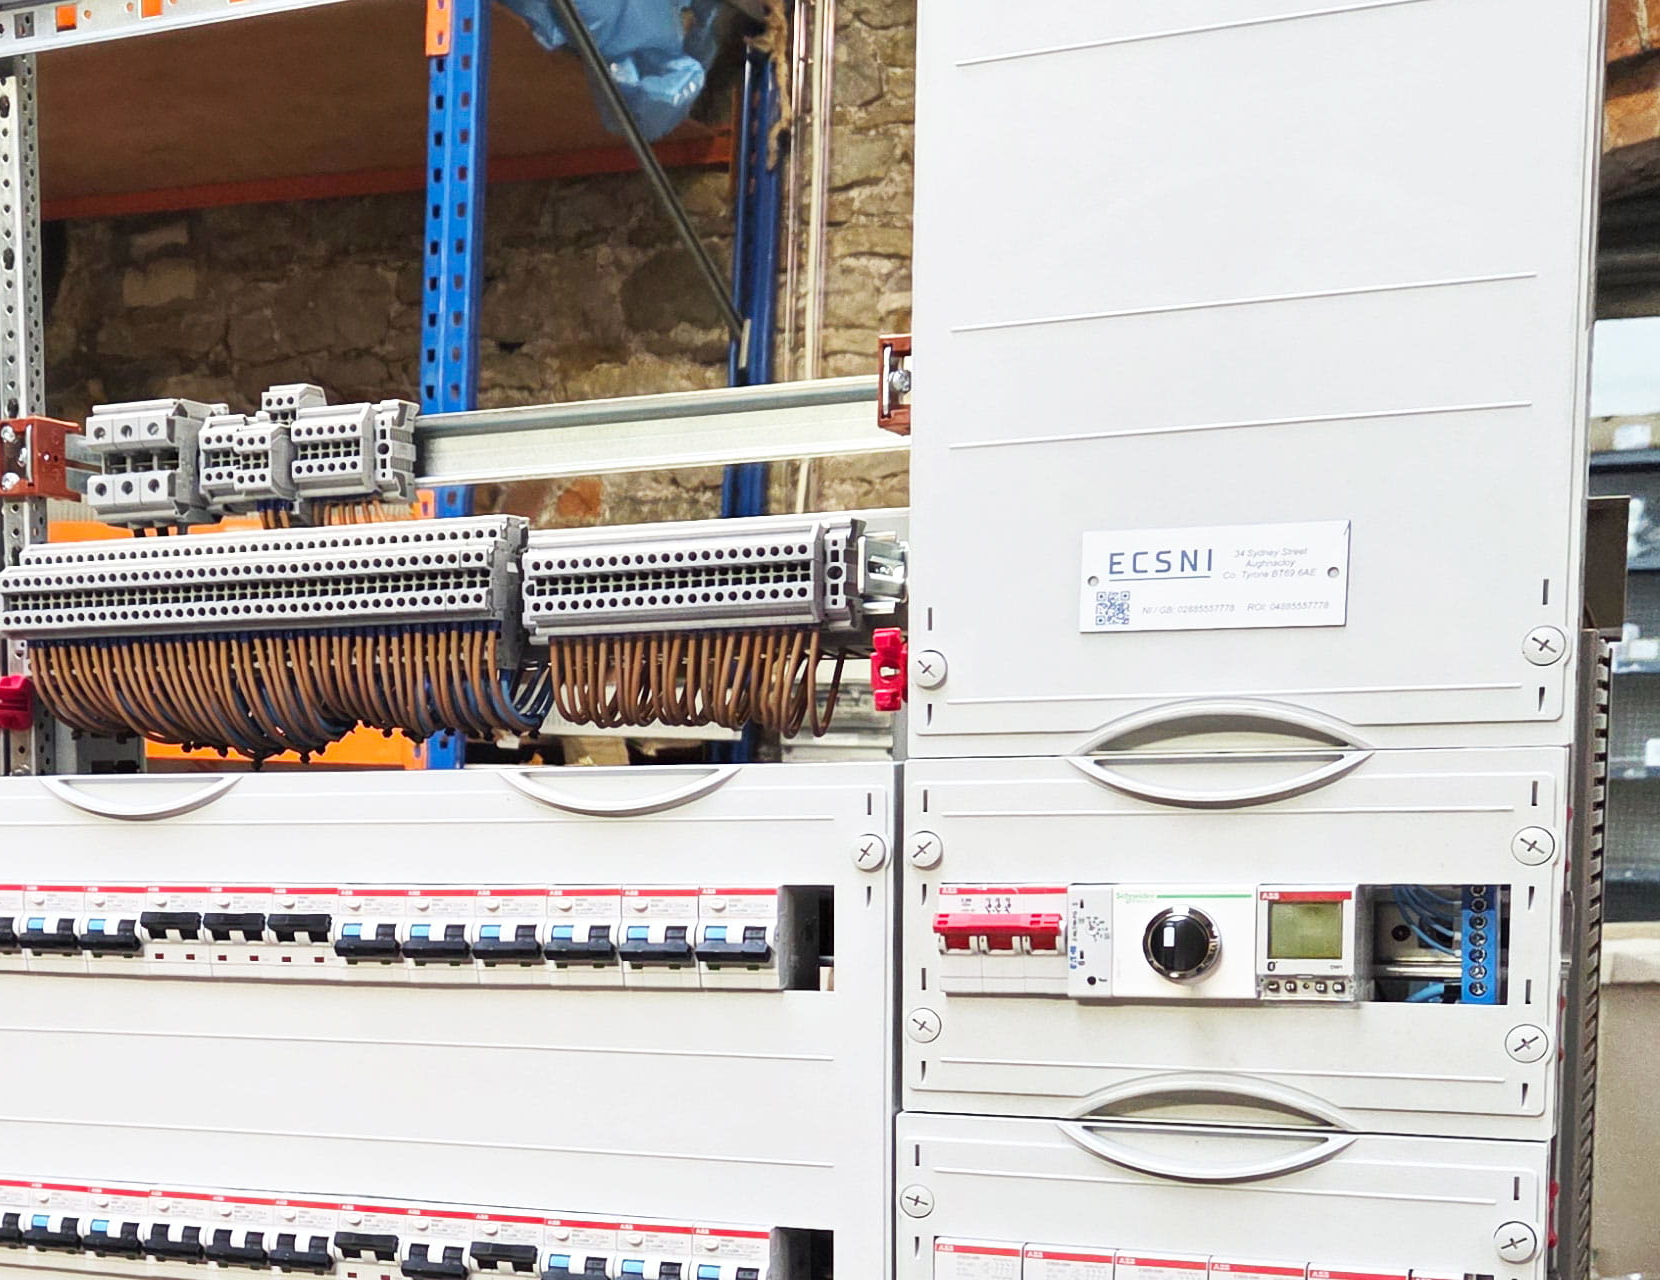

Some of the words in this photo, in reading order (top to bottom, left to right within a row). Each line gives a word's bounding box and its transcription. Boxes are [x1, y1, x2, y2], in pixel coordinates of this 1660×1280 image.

[1108, 548, 1213, 575] ECSNI
[938, 1244, 954, 1252] ABB
[1027, 1251, 1043, 1259] ABB
[1119, 1257, 1135, 1266] ABB
[1214, 1263, 1230, 1272] ABB
[1312, 1270, 1329, 1279] ABB
